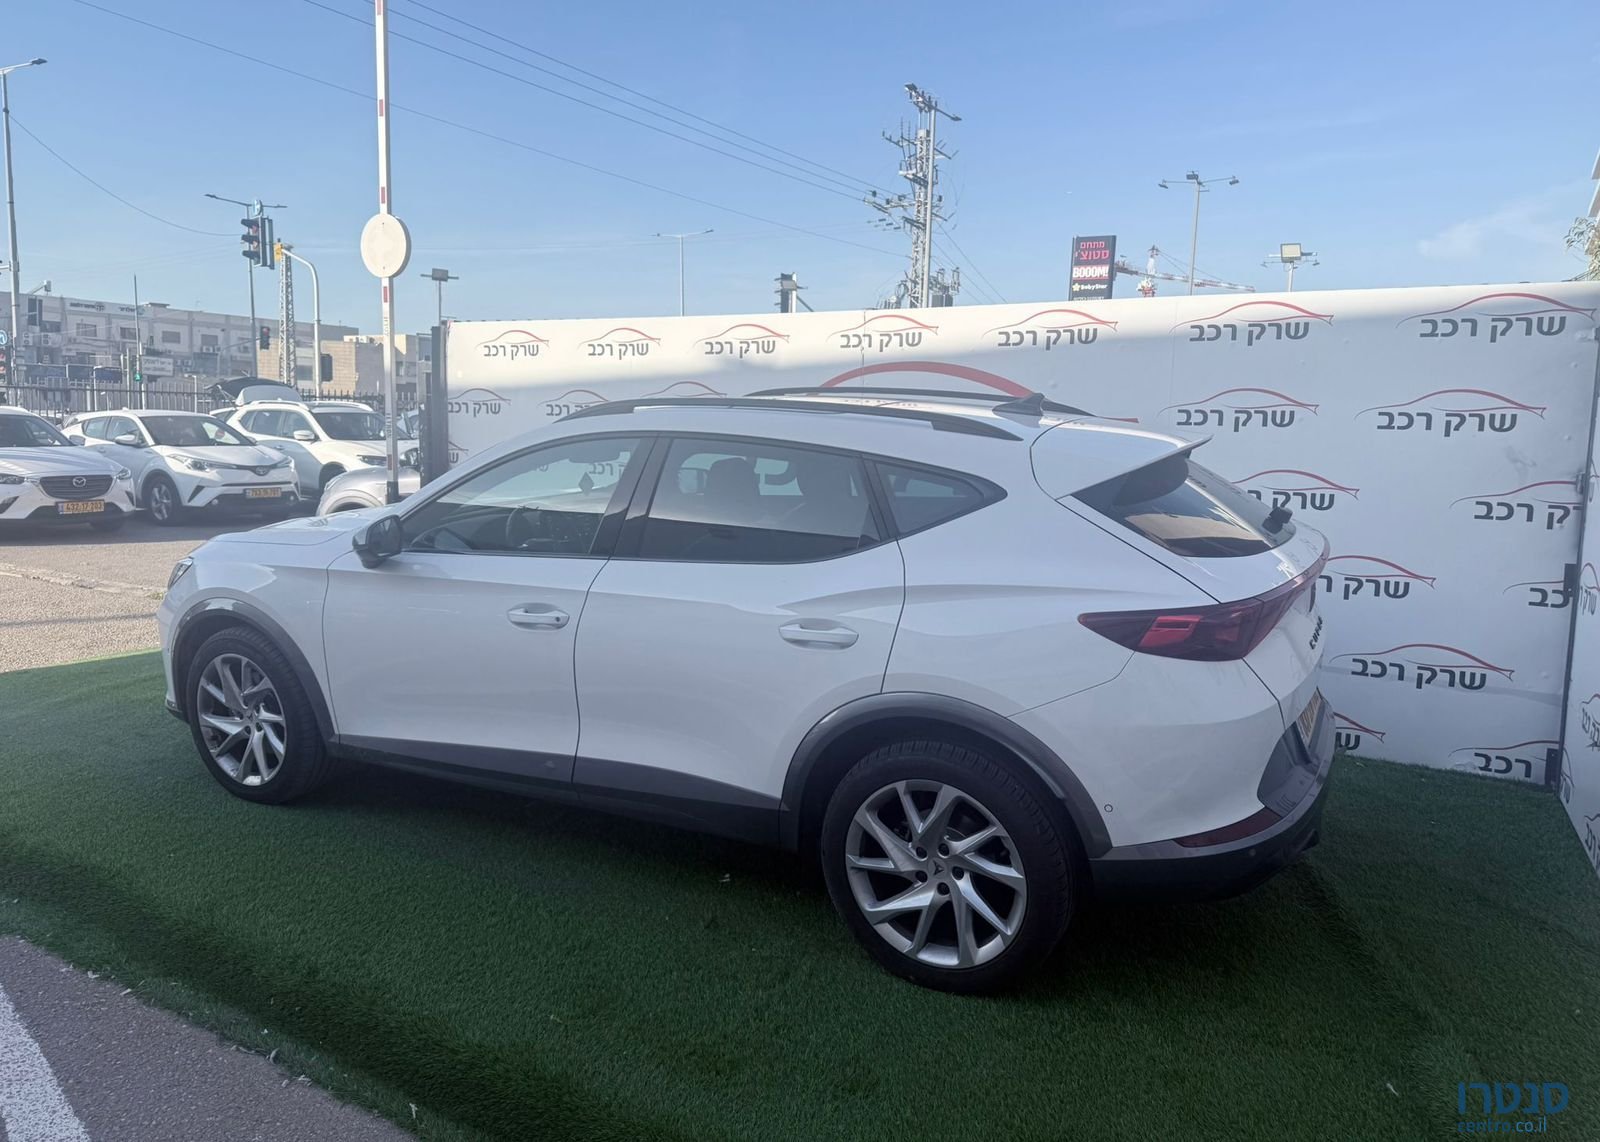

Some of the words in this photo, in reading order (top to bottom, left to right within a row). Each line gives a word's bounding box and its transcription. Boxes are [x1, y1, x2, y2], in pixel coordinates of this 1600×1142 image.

[998, 328, 1038, 346] רכב
[1190, 324, 1236, 342] רכב
[1247, 322, 1309, 346] שרק
[1420, 318, 1478, 338] רכב
[1490, 316, 1566, 343] שרק
[704, 340, 733, 355] רכב
[738, 339, 775, 358] שרק
[840, 334, 873, 348] רכב
[878, 332, 922, 351] שרק
[1045, 328, 1098, 350] שרק
[483, 345, 508, 357] רכב
[511, 345, 539, 360] שרק
[588, 343, 614, 357] רכב
[618, 343, 649, 359] שרק
[474, 401, 501, 417] שרק
[1177, 408, 1223, 426] רכב
[1233, 409, 1295, 432] שרק
[1376, 411, 1431, 430] רכב
[1444, 412, 1517, 437] שרק
[1474, 500, 1533, 522] רכב
[1344, 577, 1410, 600] שרק
[1351, 658, 1404, 681] רכב
[1416, 665, 1486, 690] שרק
[1474, 753, 1531, 778] רכב
